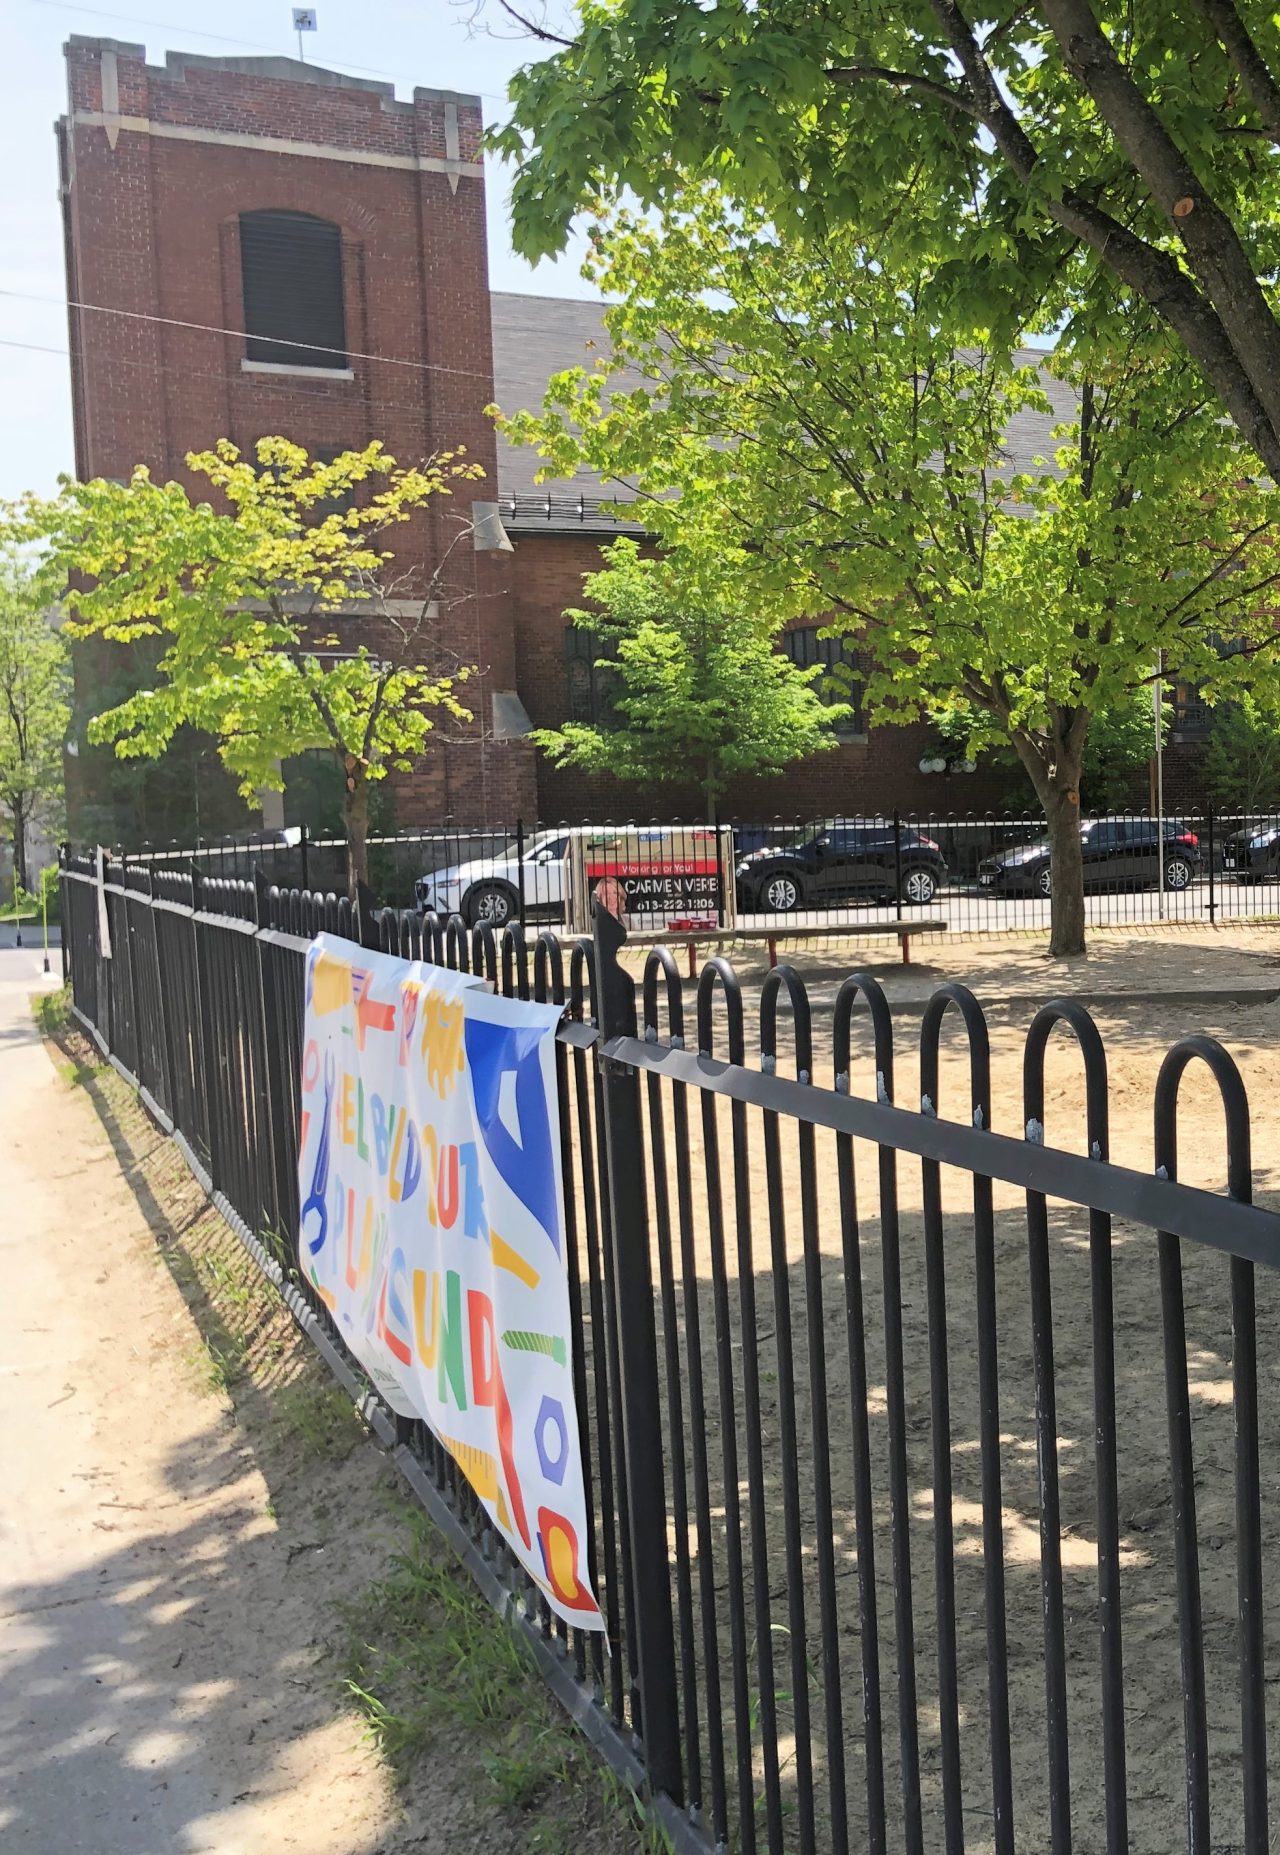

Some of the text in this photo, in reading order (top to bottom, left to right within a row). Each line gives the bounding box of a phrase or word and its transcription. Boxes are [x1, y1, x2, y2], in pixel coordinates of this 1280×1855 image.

[624, 877, 719, 894] CARMEN VERE
[336, 1070, 370, 1163] EL
[370, 1091, 423, 1204] BLD
